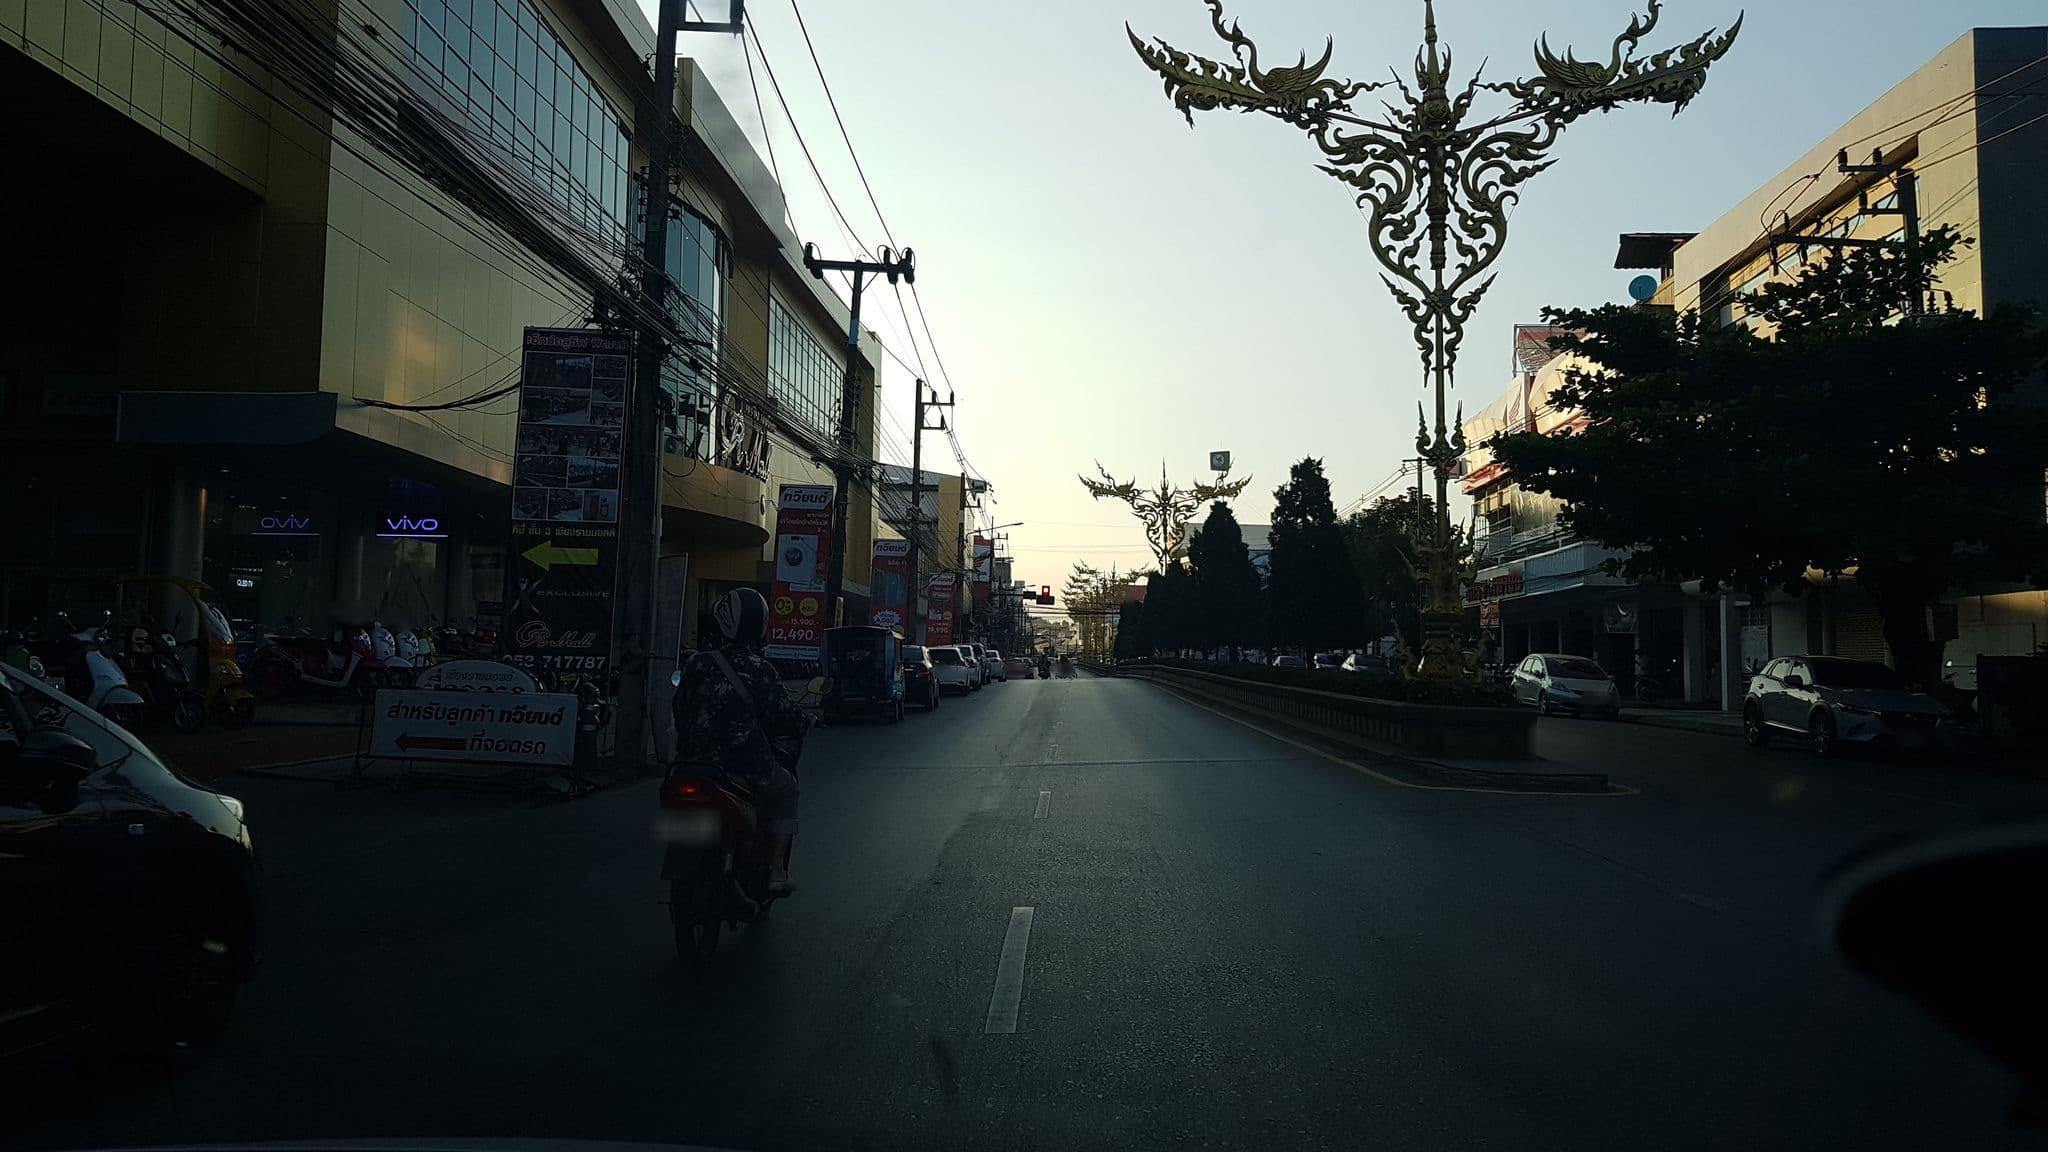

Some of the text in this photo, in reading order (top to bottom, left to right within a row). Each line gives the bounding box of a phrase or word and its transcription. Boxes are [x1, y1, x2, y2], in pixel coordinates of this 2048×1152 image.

[386, 514, 440, 531] vivo
[544, 527, 551, 536] 3
[542, 655, 606, 669] 717787
[387, 701, 566, 726] สำหรับลูกค้า ทวียนต์
[470, 729, 546, 755] ที่จอดรถ
